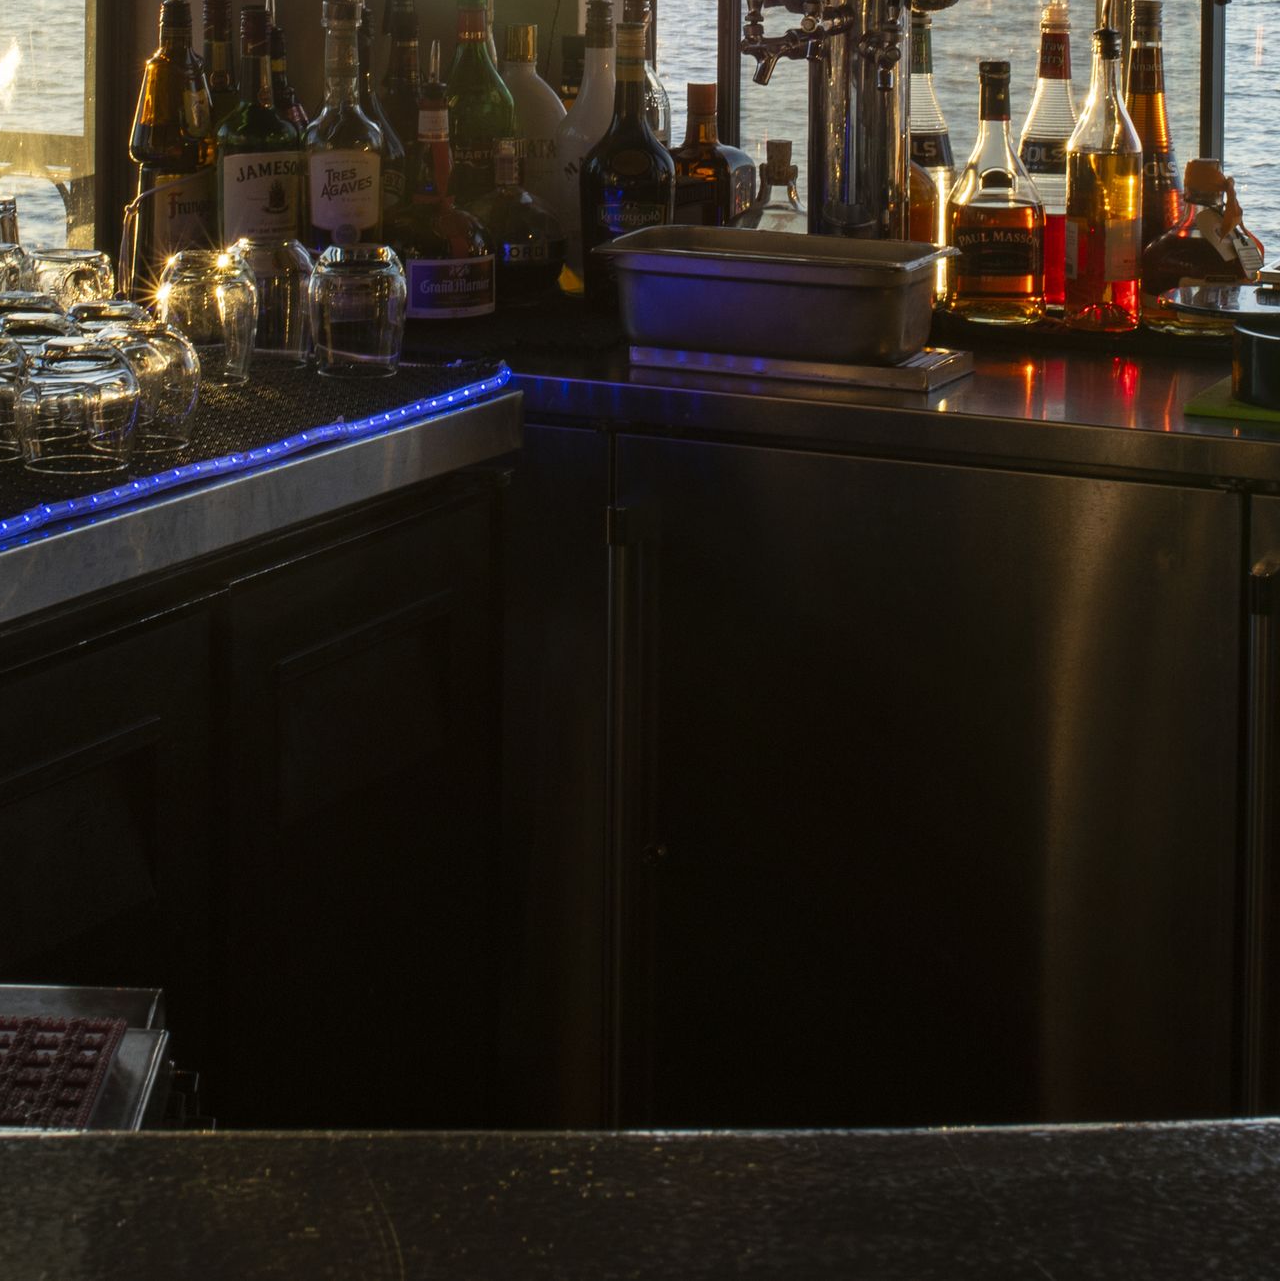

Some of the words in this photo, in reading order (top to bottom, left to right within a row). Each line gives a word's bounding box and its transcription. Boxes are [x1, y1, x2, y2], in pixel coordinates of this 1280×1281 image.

[325, 168, 358, 188] TRES
[321, 176, 373, 202] AGAVES
[958, 231, 989, 248] PAUL
[992, 229, 1041, 247] MASSON
[419, 278, 454, 294] Grand
